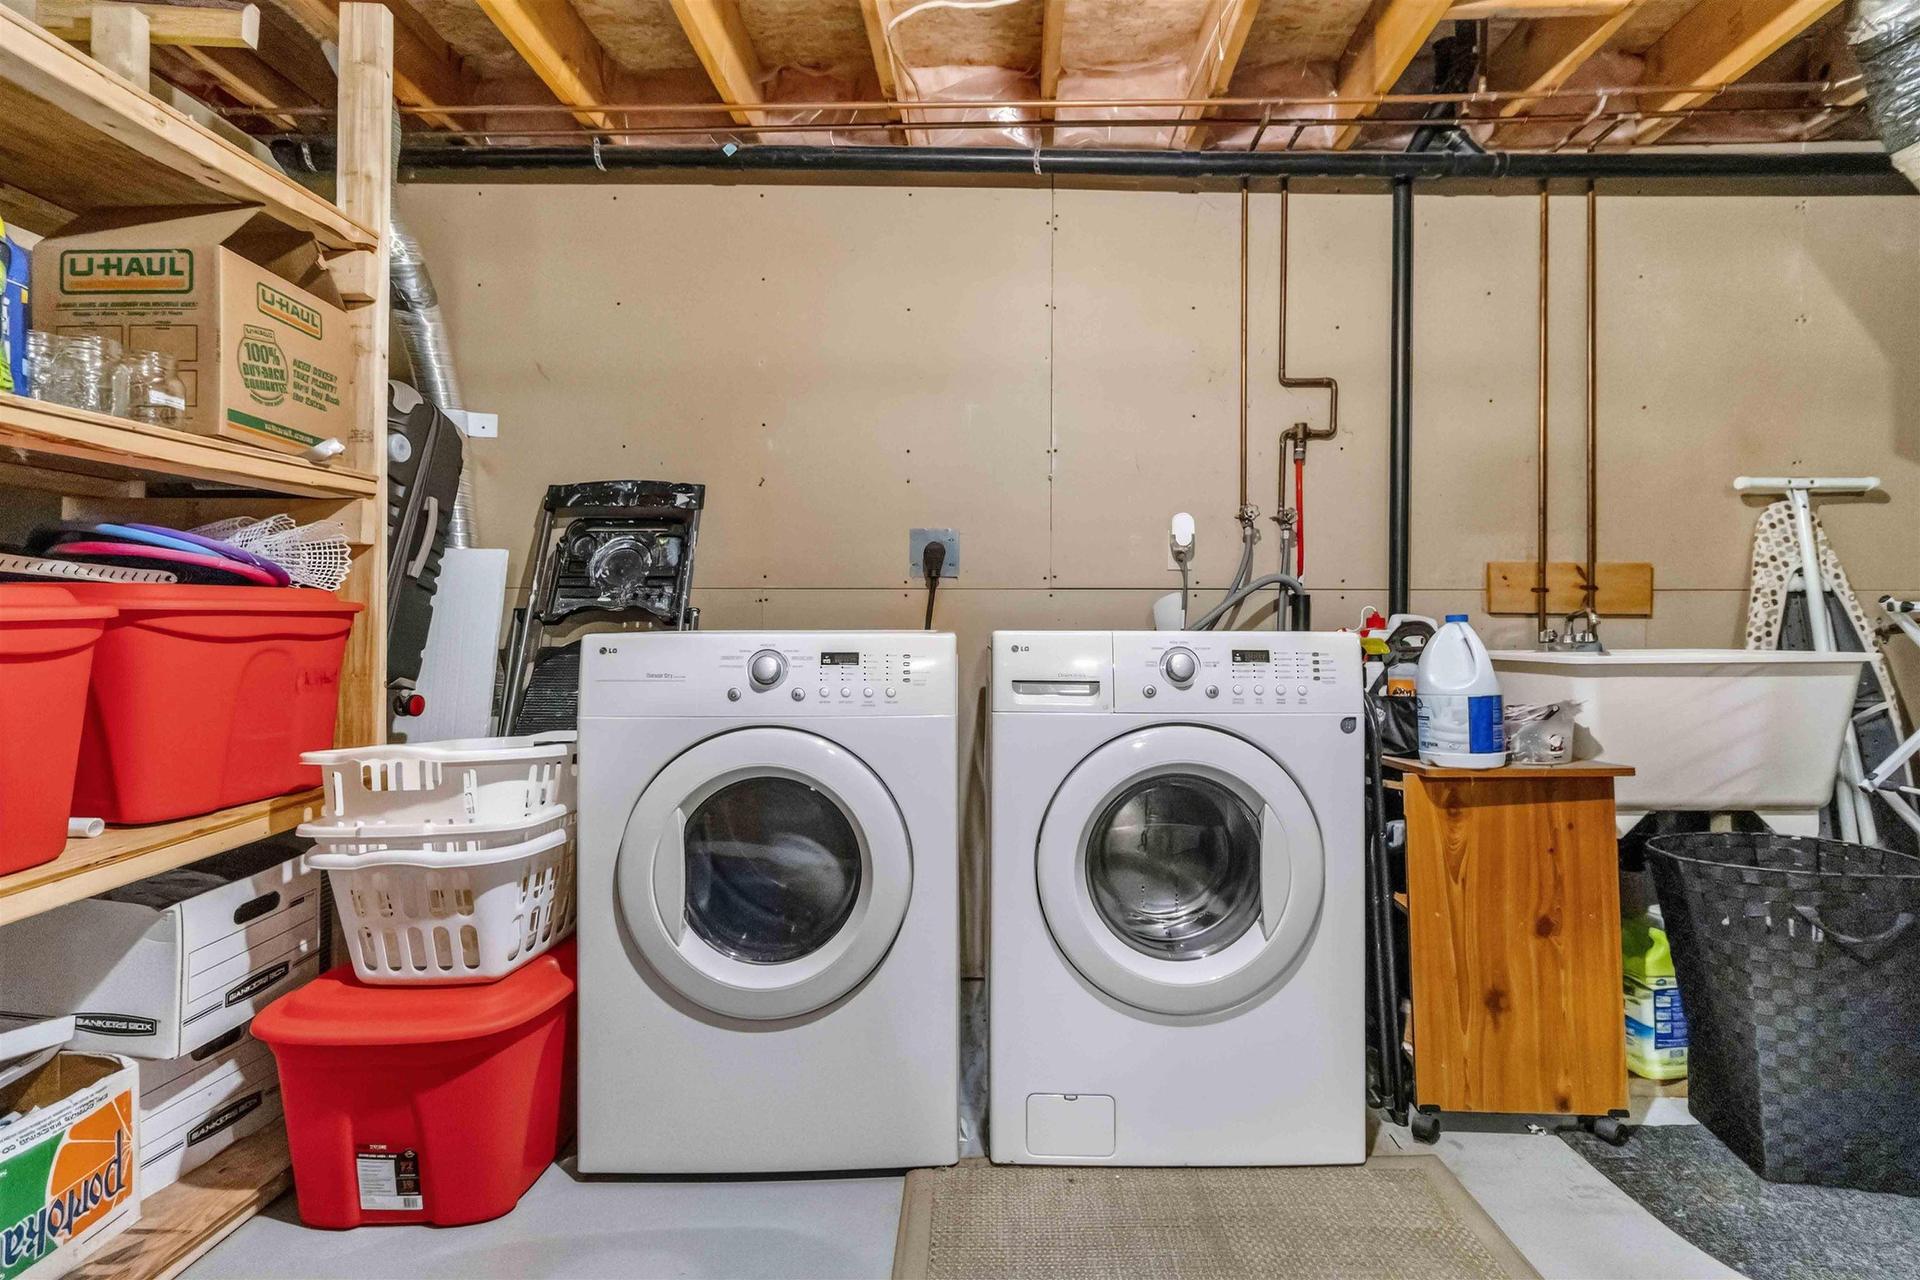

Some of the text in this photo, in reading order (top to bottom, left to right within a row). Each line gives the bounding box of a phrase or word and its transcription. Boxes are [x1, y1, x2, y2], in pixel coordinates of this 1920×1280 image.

[70, 256, 184, 277] U-HAUL
[262, 288, 319, 329] U-HAUL
[244, 342, 280, 366] 100%
[77, 1017, 153, 1031] BANKERS BOX
[192, 1108, 238, 1141] BANKERS
